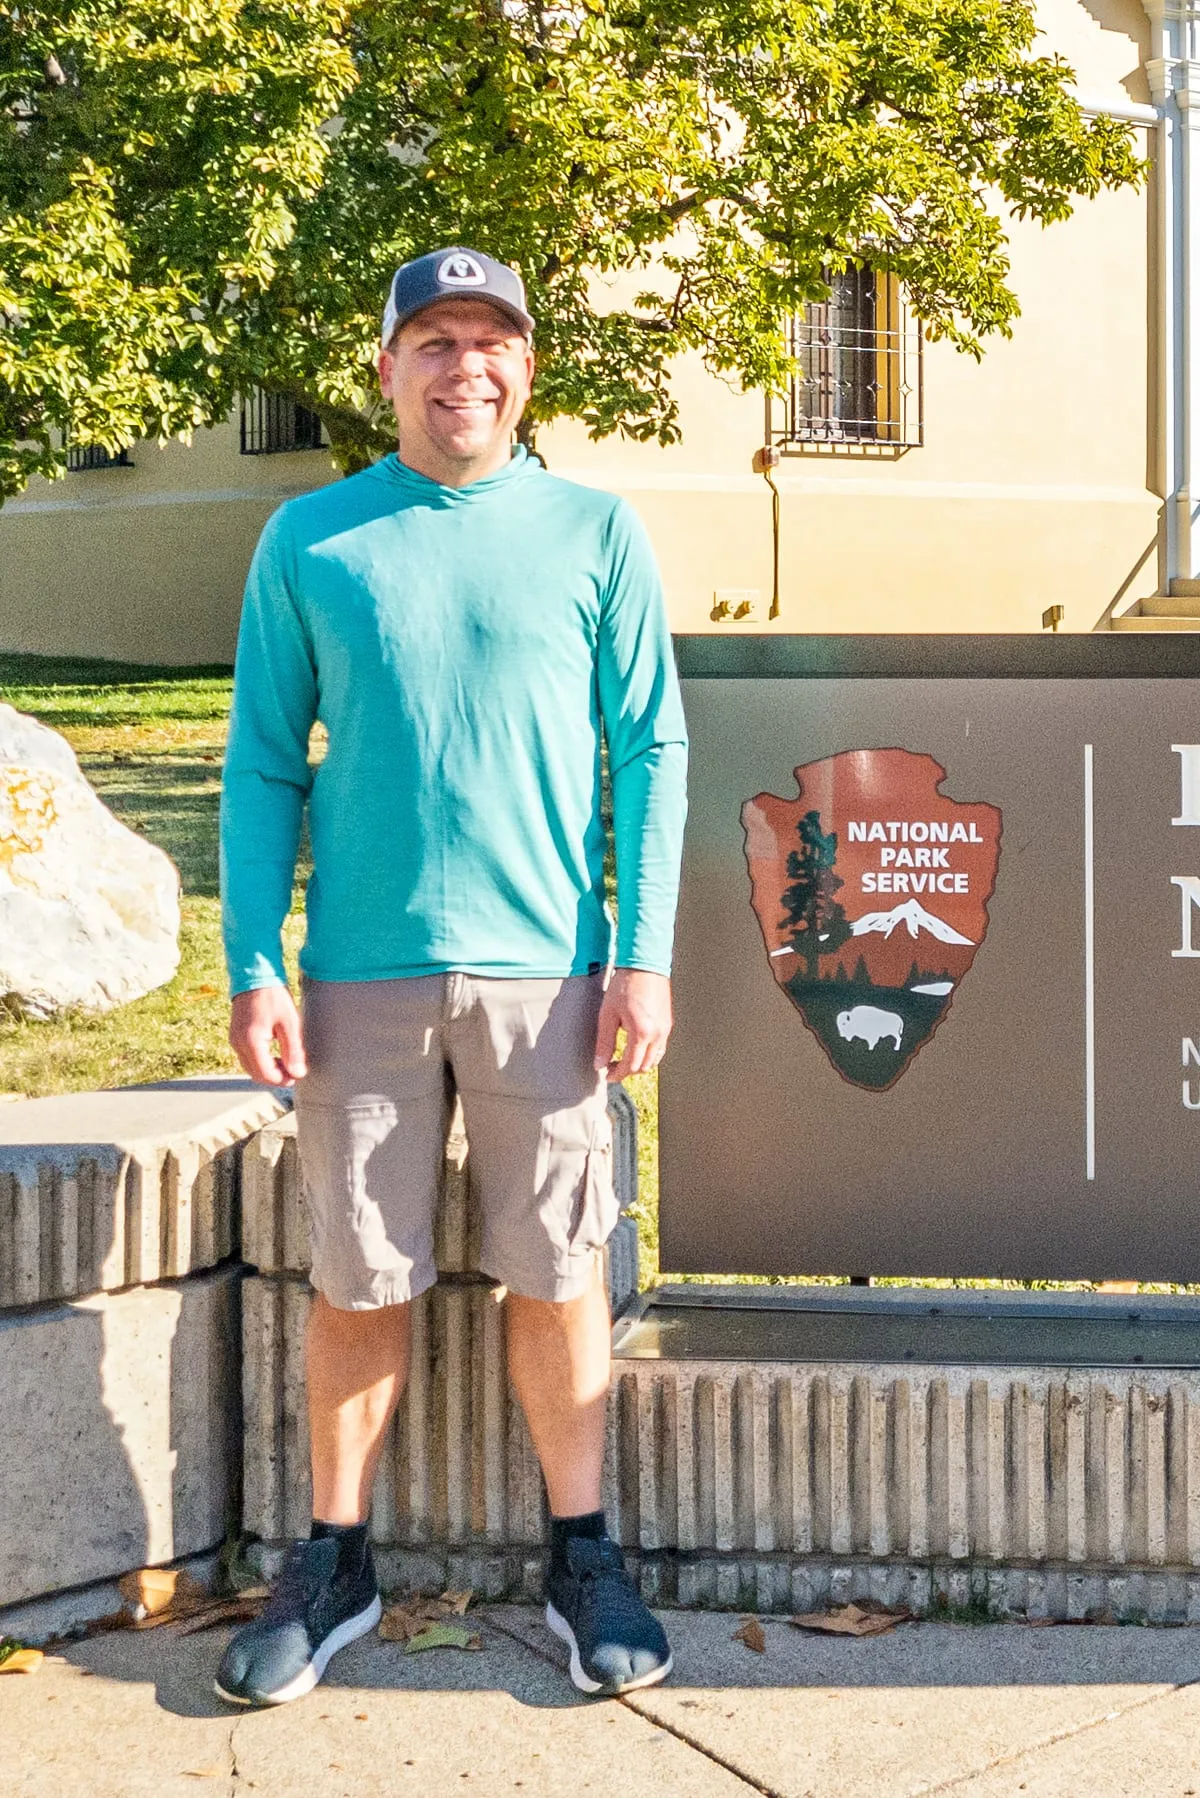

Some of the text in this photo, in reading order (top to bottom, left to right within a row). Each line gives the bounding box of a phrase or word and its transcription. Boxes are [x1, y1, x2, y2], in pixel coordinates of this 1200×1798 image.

[847, 821, 984, 844] NATIONAL
[880, 847, 950, 869] PARK
[860, 872, 970, 894] SERVICE
